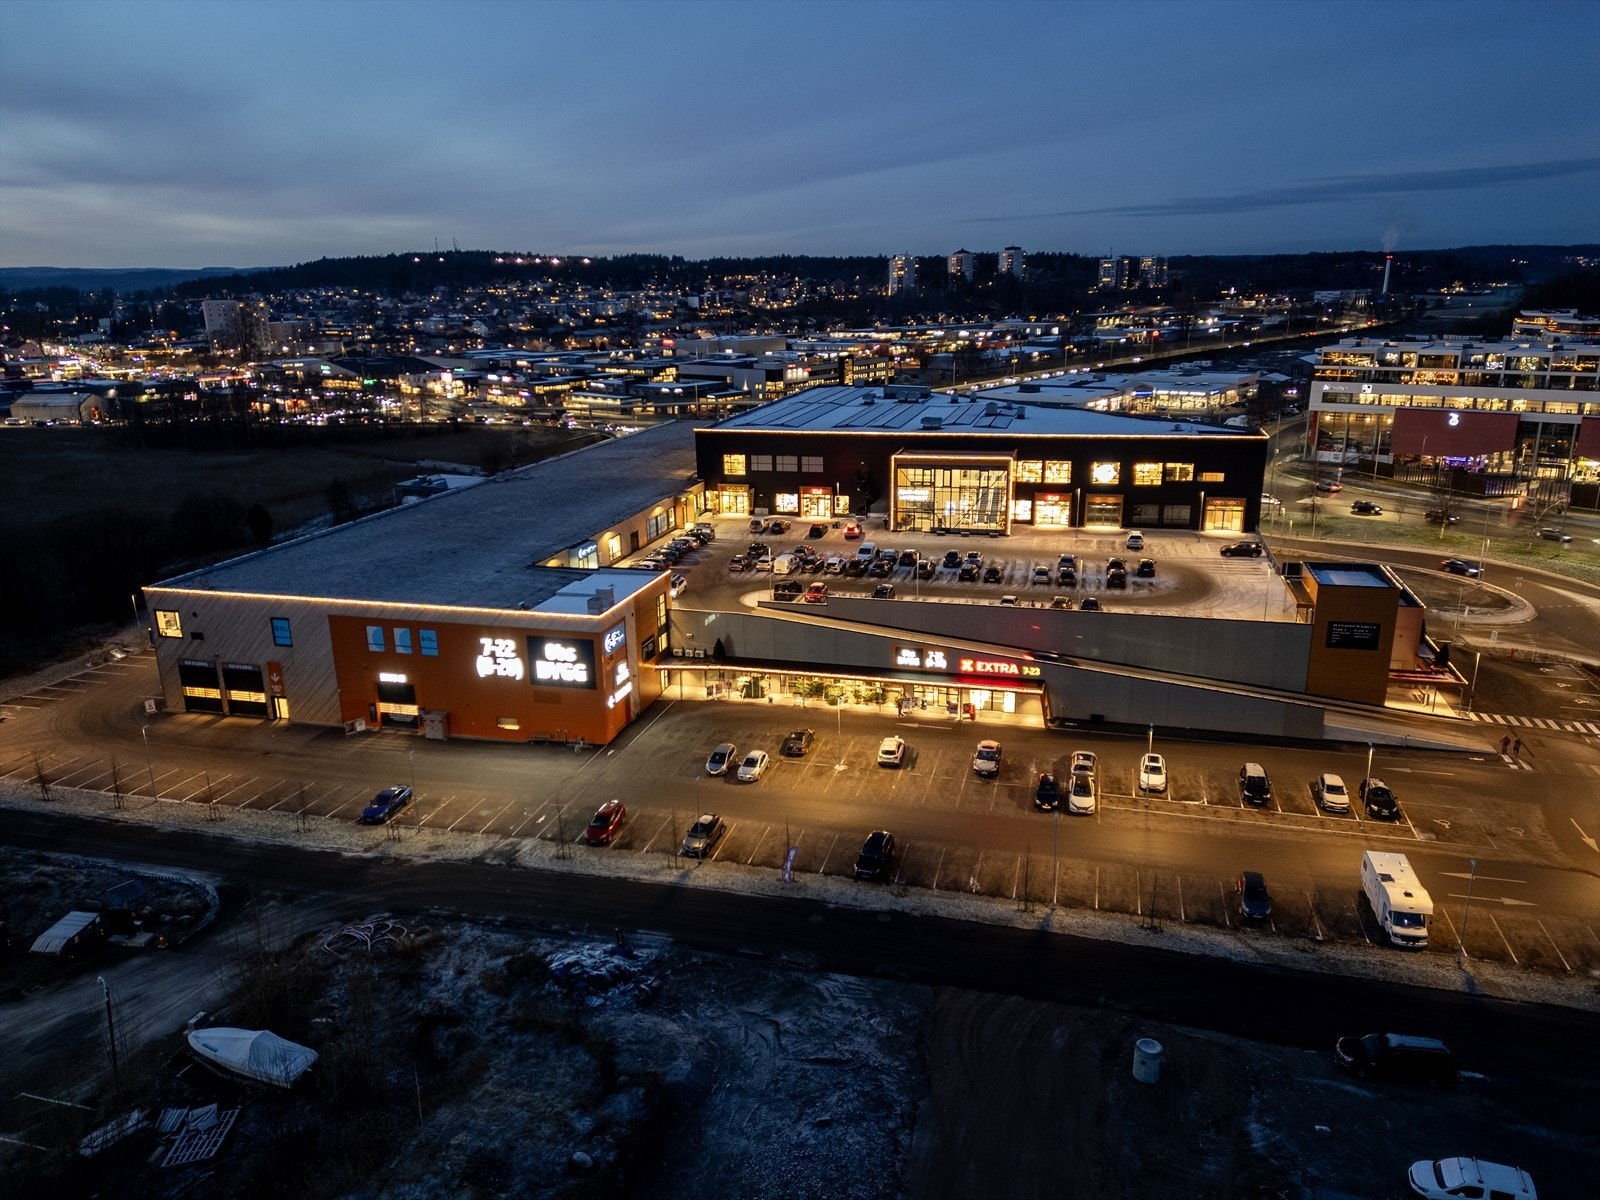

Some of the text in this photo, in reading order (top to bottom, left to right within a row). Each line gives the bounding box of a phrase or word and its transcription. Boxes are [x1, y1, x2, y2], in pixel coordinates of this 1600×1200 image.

[480, 637, 516, 657] 7-22
[976, 661, 1019, 675] EXTRA
[1022, 665, 1041, 676] 7-23
